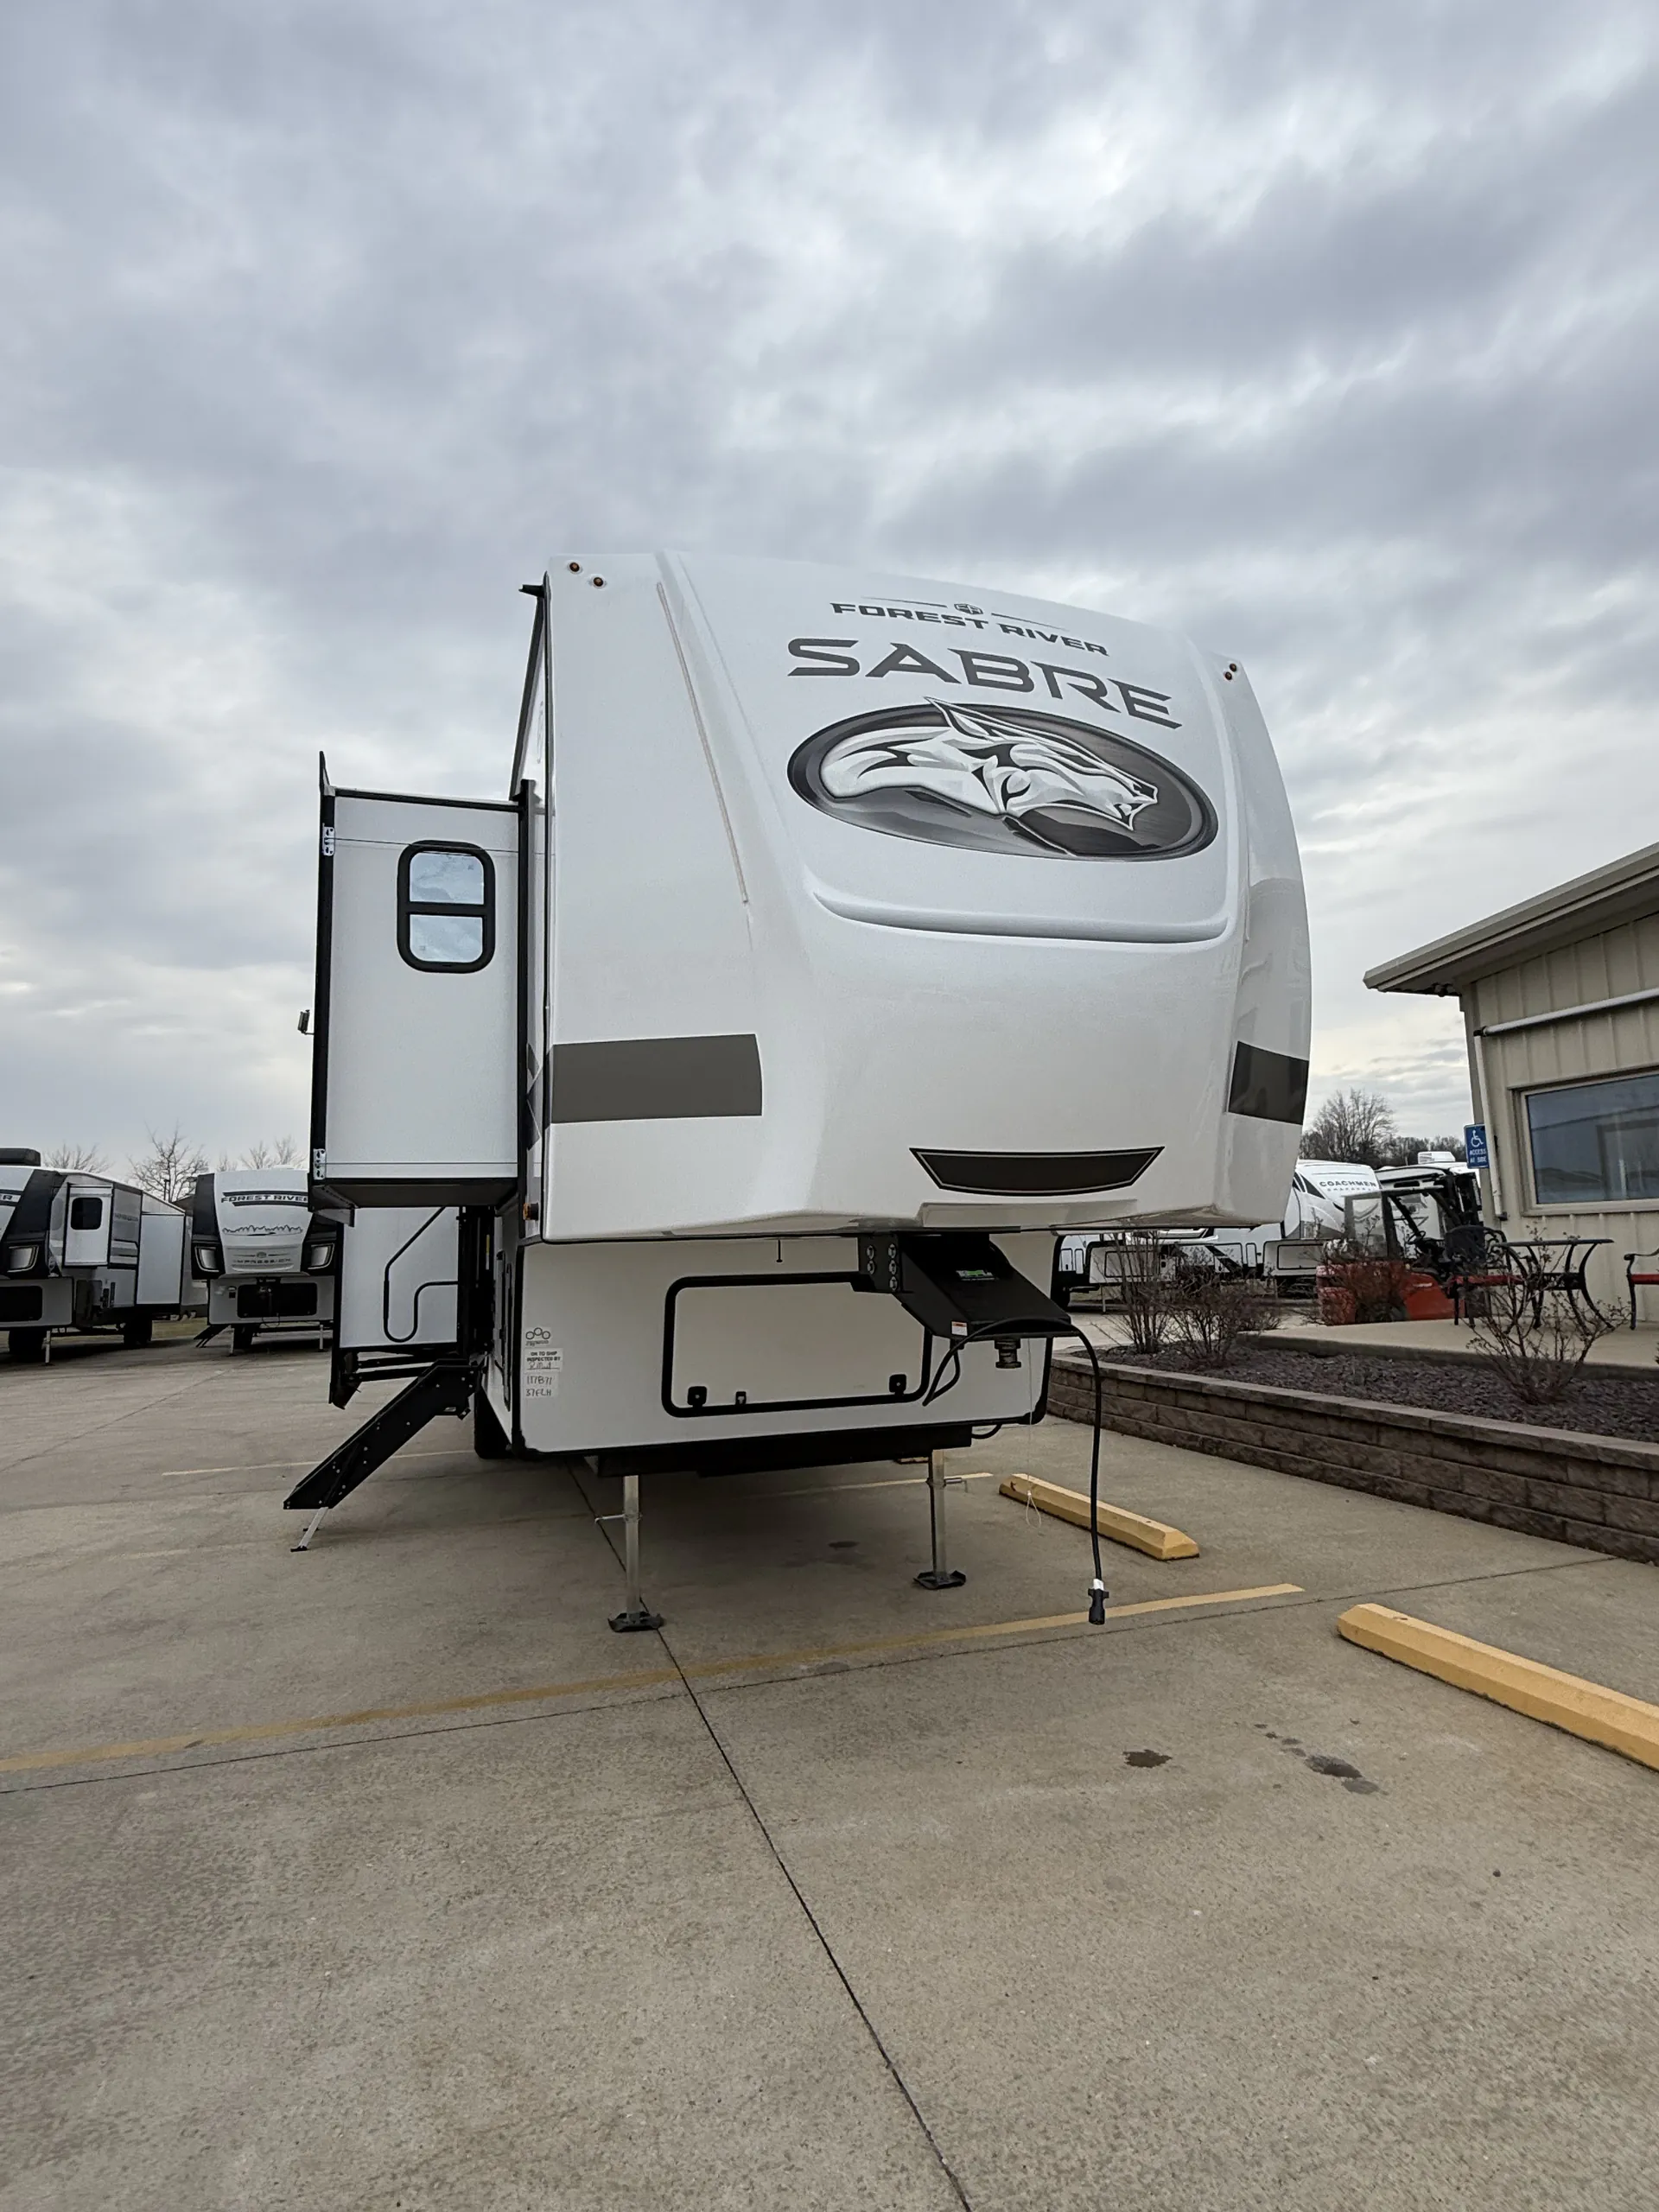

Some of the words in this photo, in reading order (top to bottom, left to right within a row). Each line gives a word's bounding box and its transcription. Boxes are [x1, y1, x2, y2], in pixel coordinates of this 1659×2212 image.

[830, 602, 989, 630] FOREST
[996, 622, 1110, 657] RIVER
[787, 638, 1184, 730] SABRE
